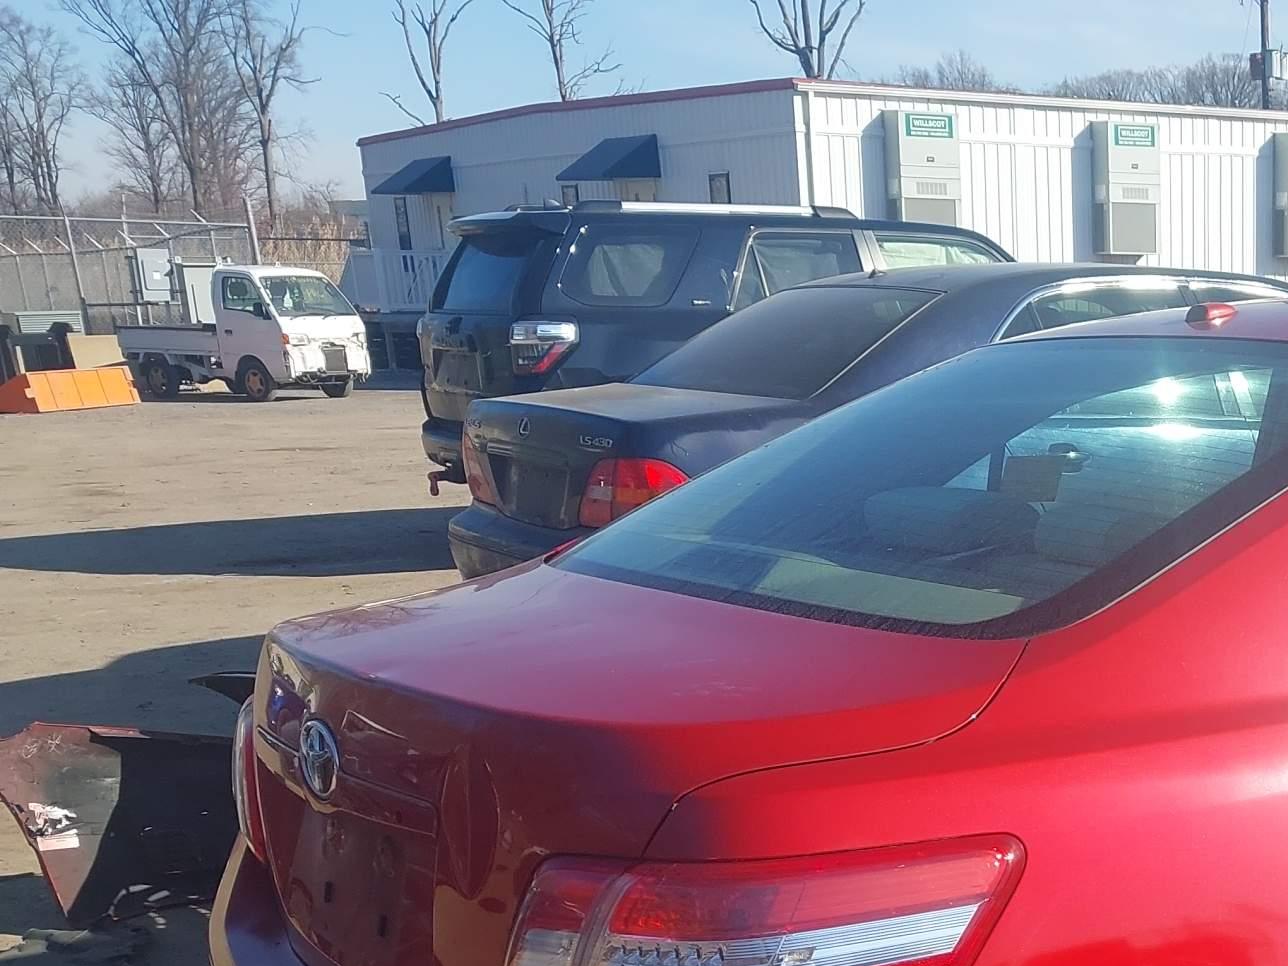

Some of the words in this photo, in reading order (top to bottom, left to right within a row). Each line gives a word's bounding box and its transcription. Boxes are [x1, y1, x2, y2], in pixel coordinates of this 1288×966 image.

[913, 119, 945, 128] WILLSCOT
[1121, 130, 1149, 138] WILLSCOT
[579, 435, 614, 448] LS430
